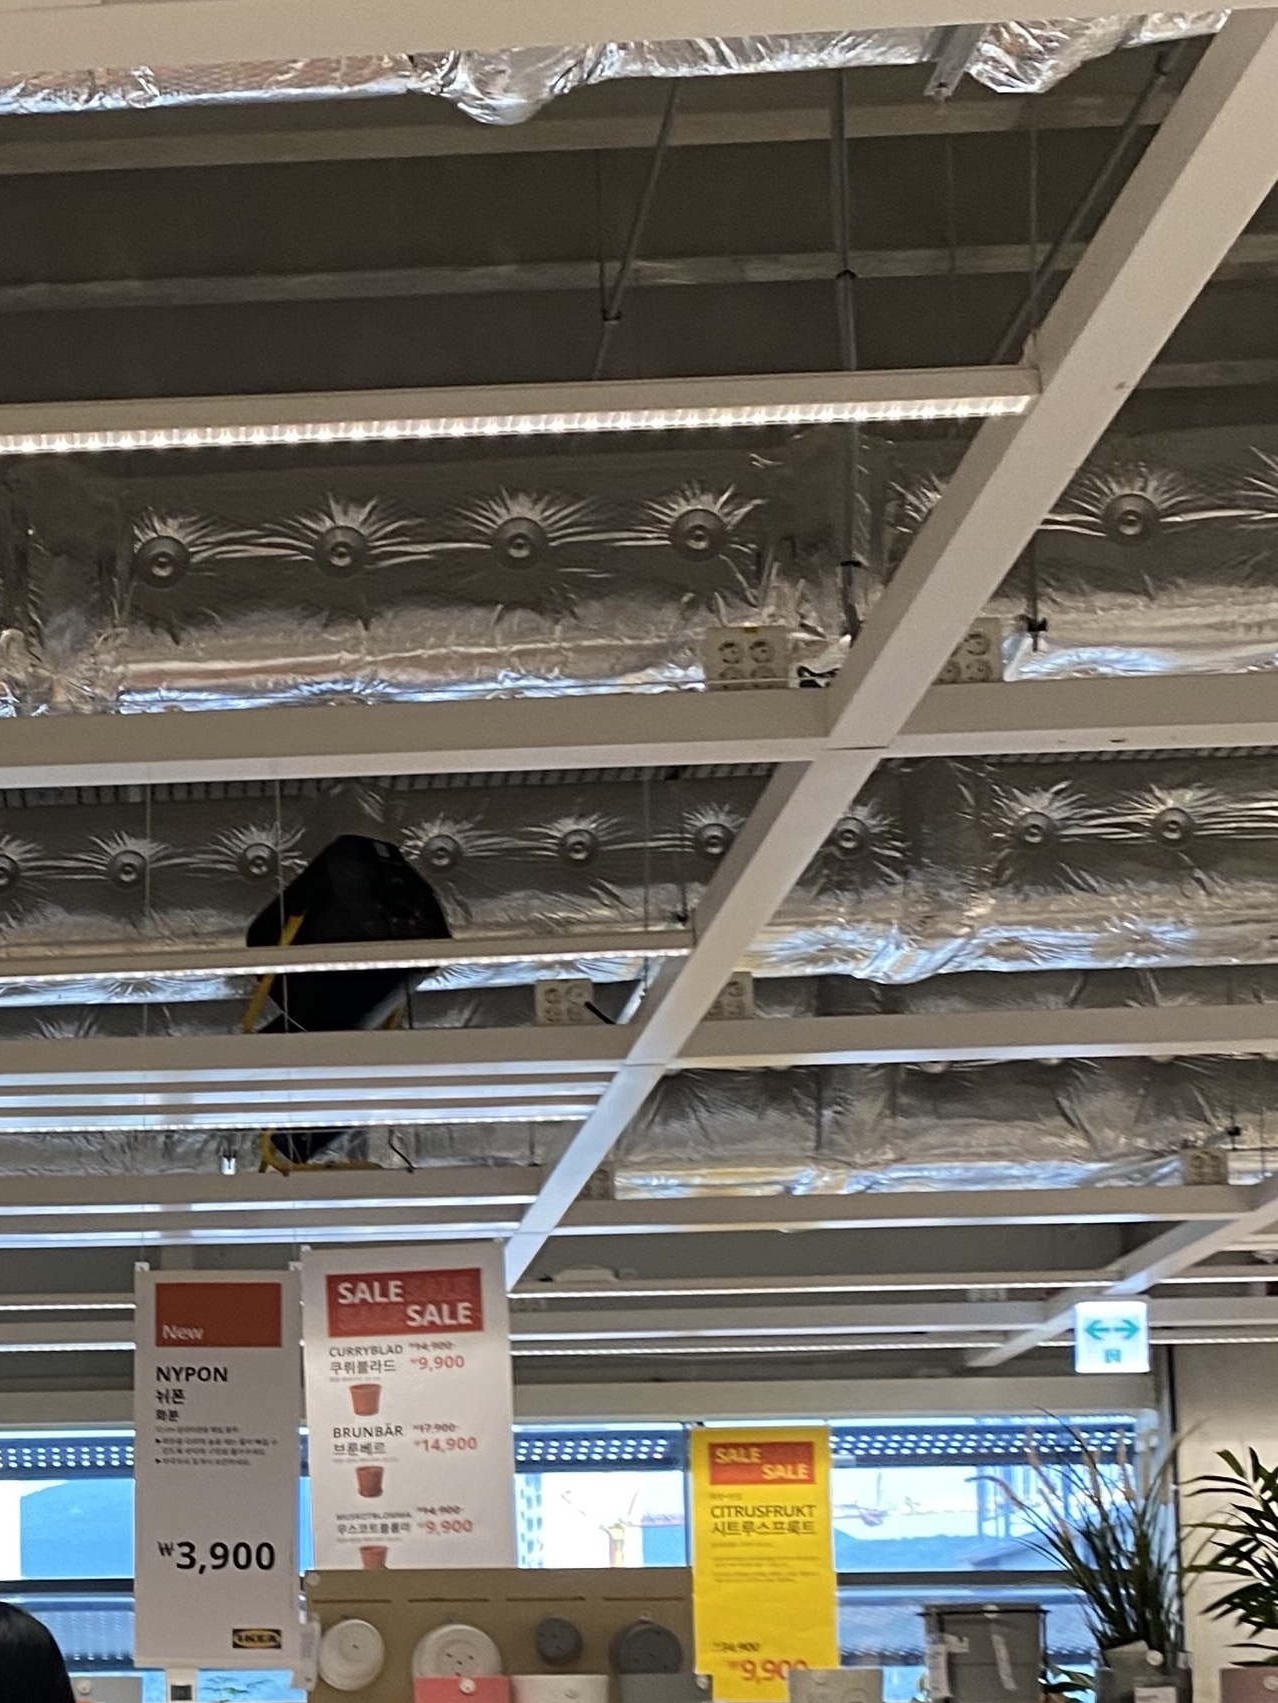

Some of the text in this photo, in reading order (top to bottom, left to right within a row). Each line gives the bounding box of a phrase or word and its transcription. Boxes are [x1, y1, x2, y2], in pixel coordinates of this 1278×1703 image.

[337, 1280, 404, 1305] SALE
[406, 1302, 474, 1327] SALE
[162, 1324, 205, 1340] New
[329, 1344, 403, 1359] CURRYBLAD
[155, 1366, 229, 1383] NYPON
[333, 1422, 404, 1439] BRUNBÄR
[715, 1448, 762, 1464] SALE
[762, 1464, 809, 1480] SALE
[710, 1504, 817, 1519] CITRUSFRUKT
[157, 1541, 276, 1575] ₩3,900
